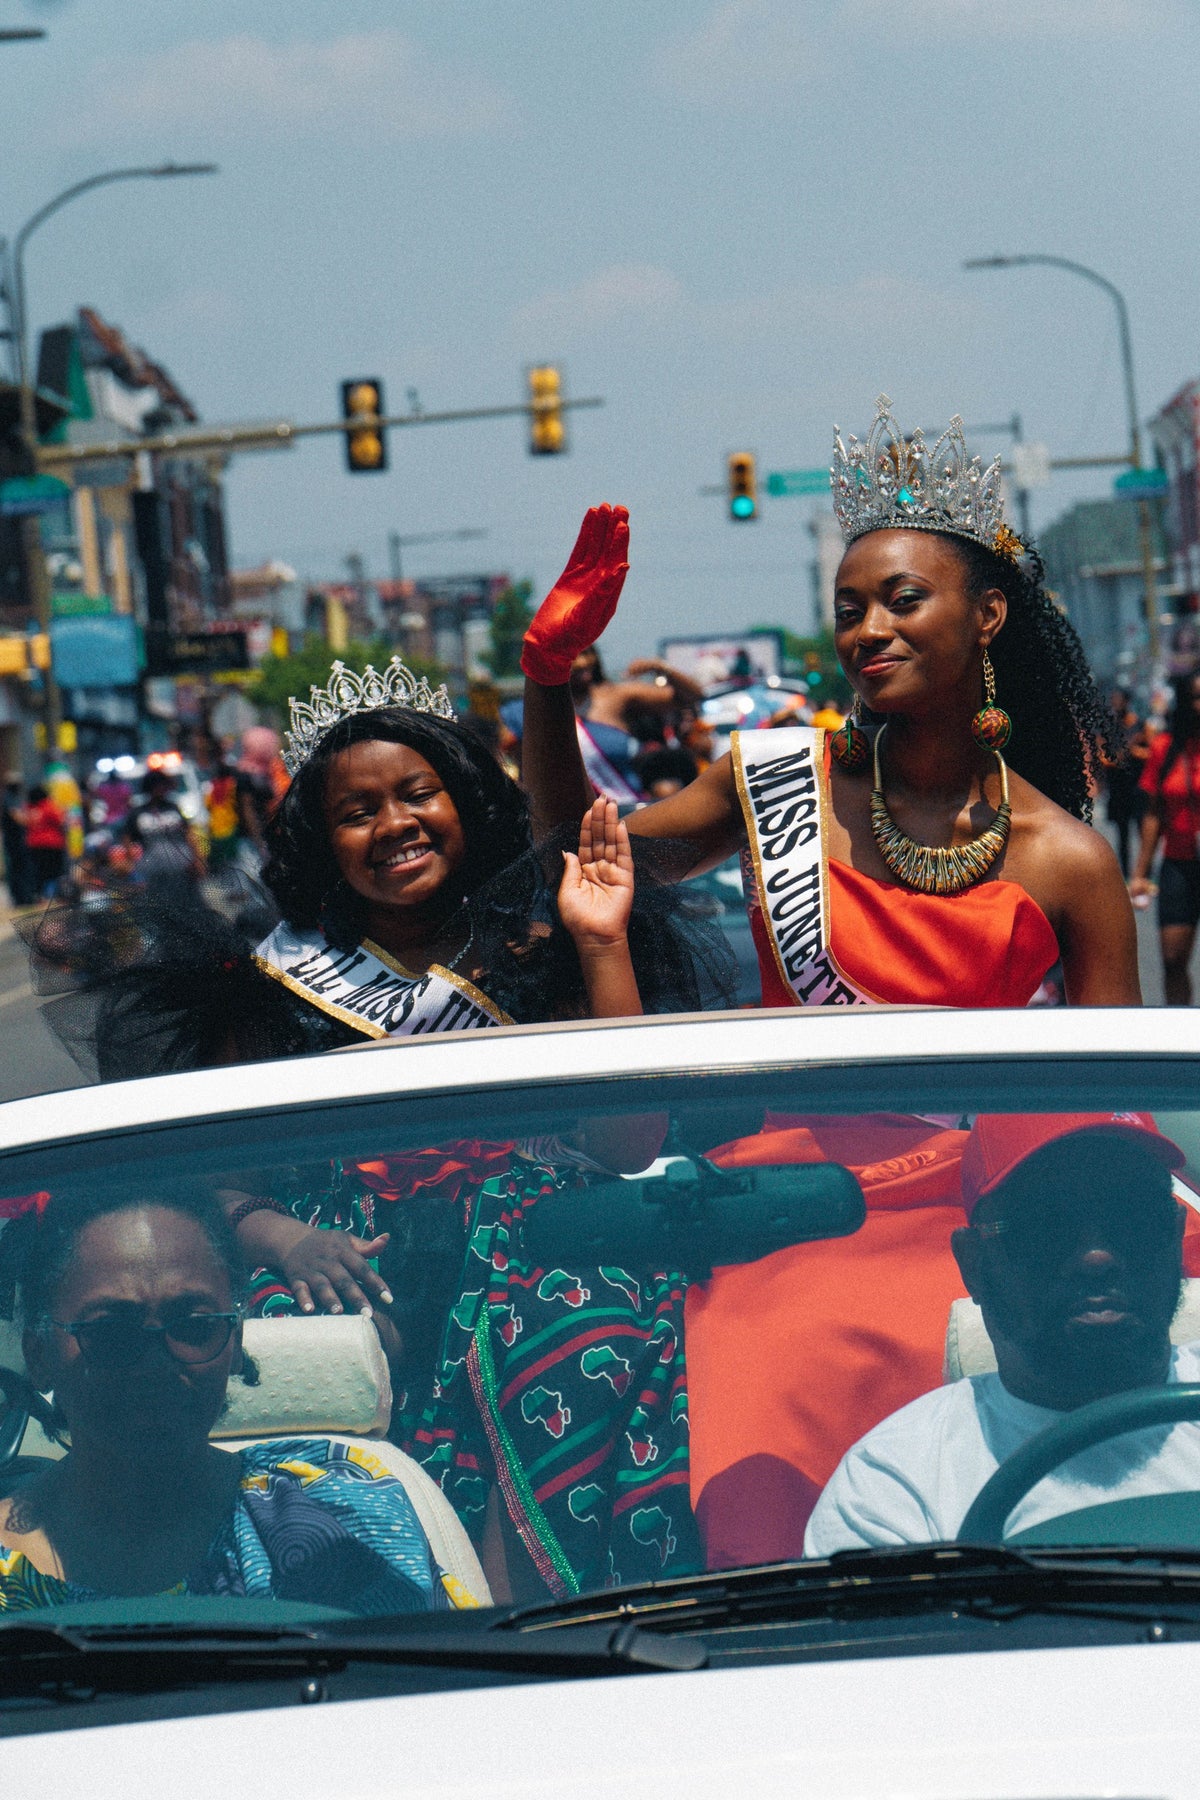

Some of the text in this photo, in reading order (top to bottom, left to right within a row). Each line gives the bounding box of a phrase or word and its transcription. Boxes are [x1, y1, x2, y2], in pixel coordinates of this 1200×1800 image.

[745, 746, 867, 1006] MISS JUNETE
[285, 944, 368, 995] LIL
[331, 970, 433, 1033] MISS
